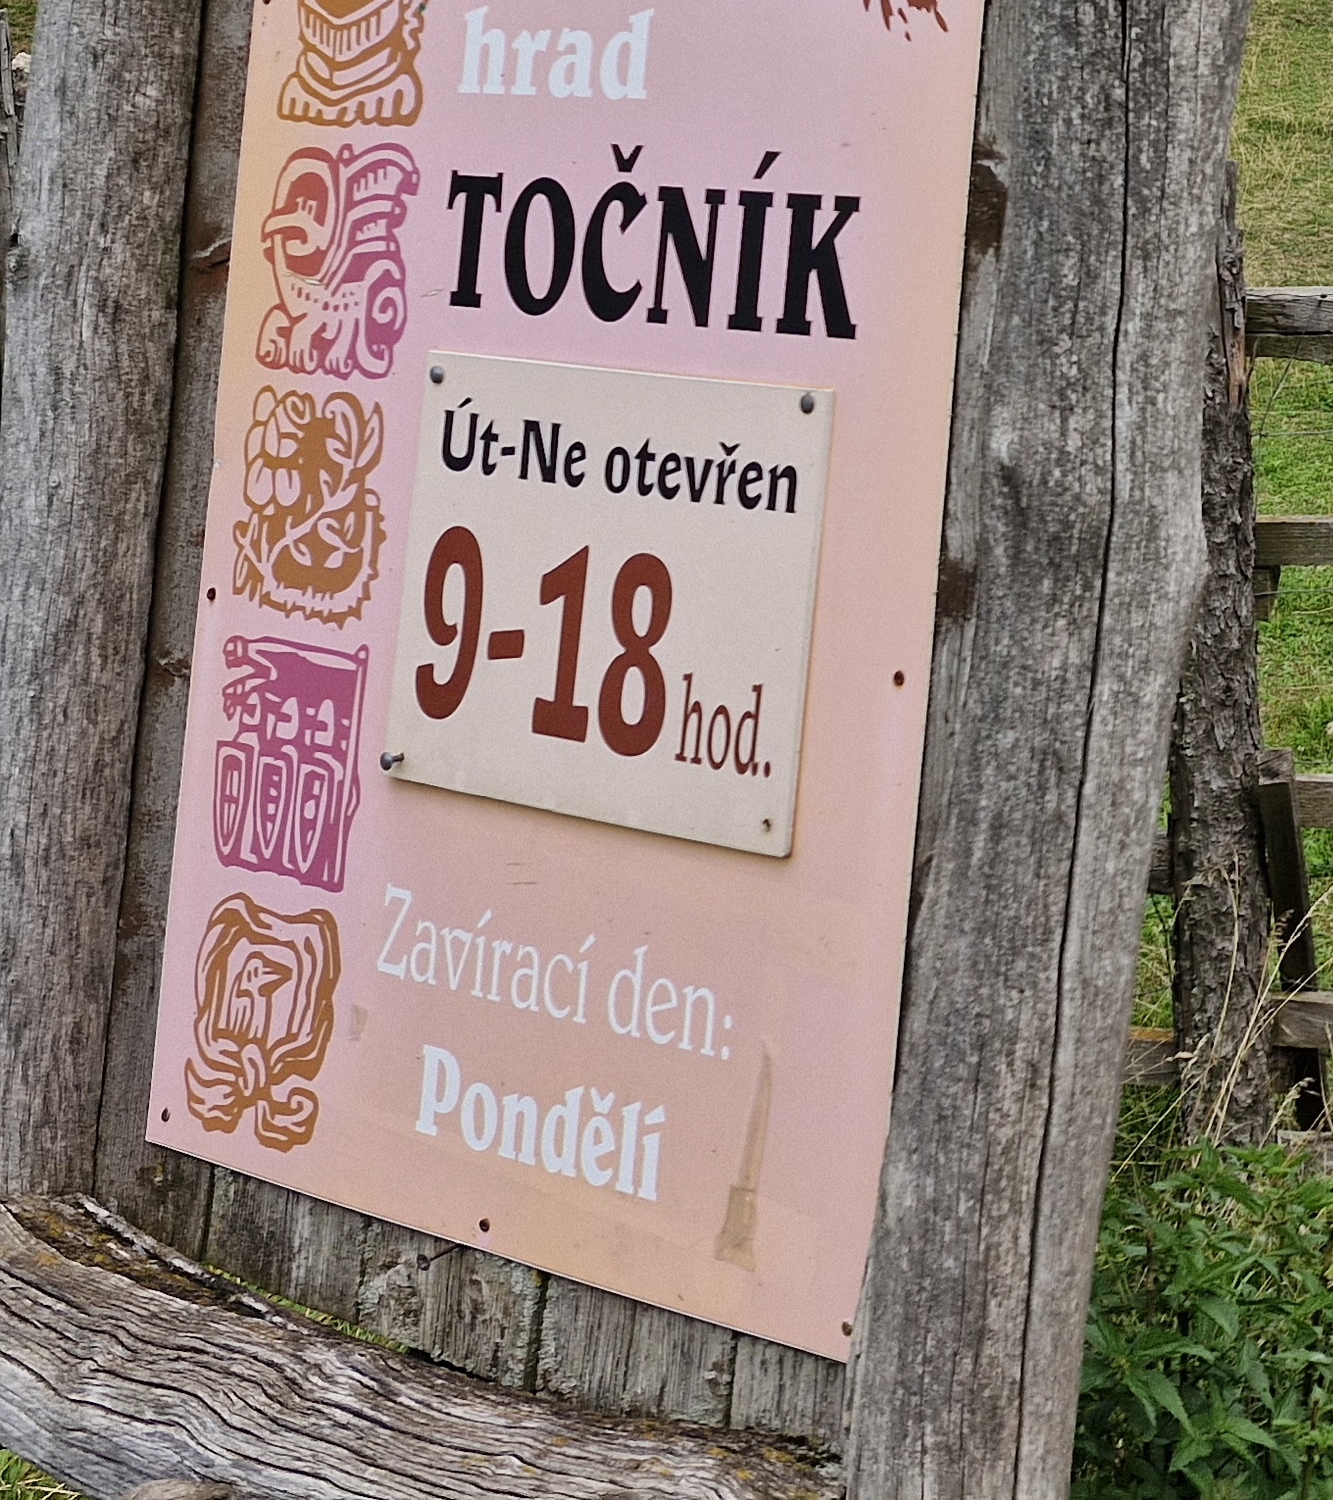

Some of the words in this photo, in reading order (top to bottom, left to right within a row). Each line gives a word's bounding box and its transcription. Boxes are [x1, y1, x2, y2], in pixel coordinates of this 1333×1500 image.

[457, 6, 655, 100] hrad
[446, 143, 861, 340] TOČNÍK
[441, 397, 587, 488] Út-Ne
[604, 438, 798, 514] otevřen
[415, 525, 673, 757] 9-18
[674, 673, 771, 778] hod.
[377, 883, 596, 1025] Zavírací
[607, 945, 733, 1061] den:
[415, 1044, 666, 1202] Pondělí
